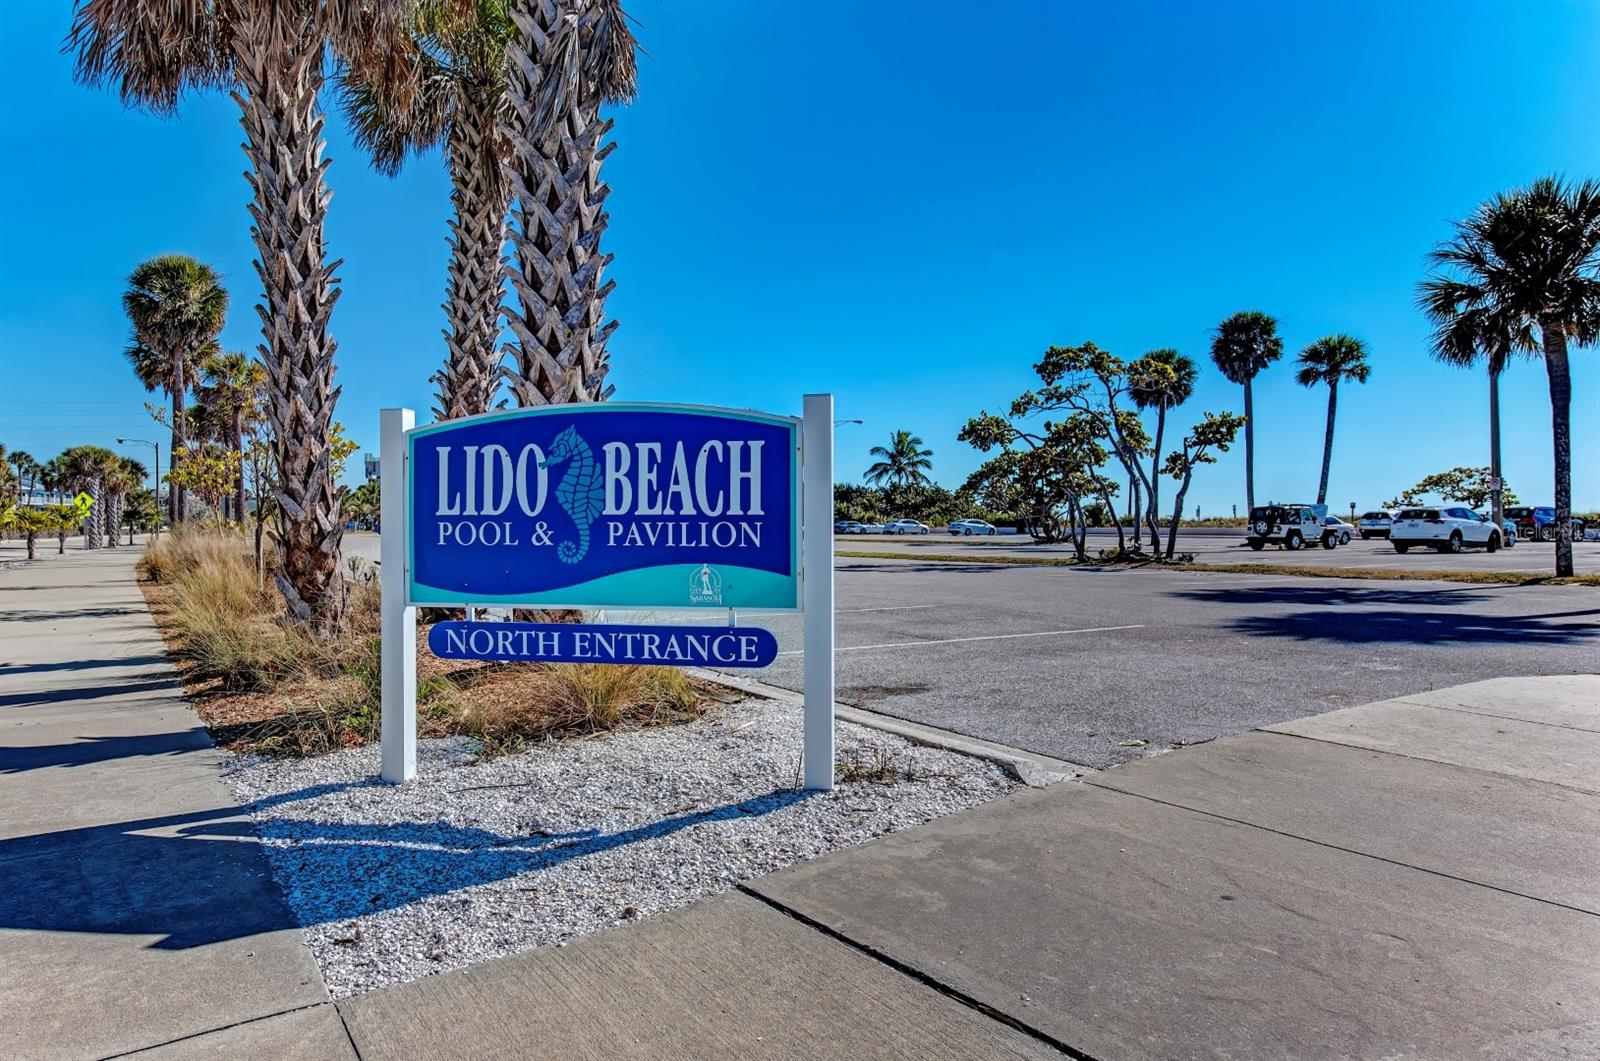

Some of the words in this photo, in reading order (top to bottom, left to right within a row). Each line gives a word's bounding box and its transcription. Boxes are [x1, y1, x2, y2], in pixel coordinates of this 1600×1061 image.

[435, 443, 549, 517] LIDO
[602, 439, 766, 517] BEACH
[436, 521, 519, 546] POOL
[531, 520, 555, 546] &
[606, 521, 763, 547] PAVILION
[445, 628, 562, 657] NORTH
[572, 632, 759, 663] ENTRANCE
